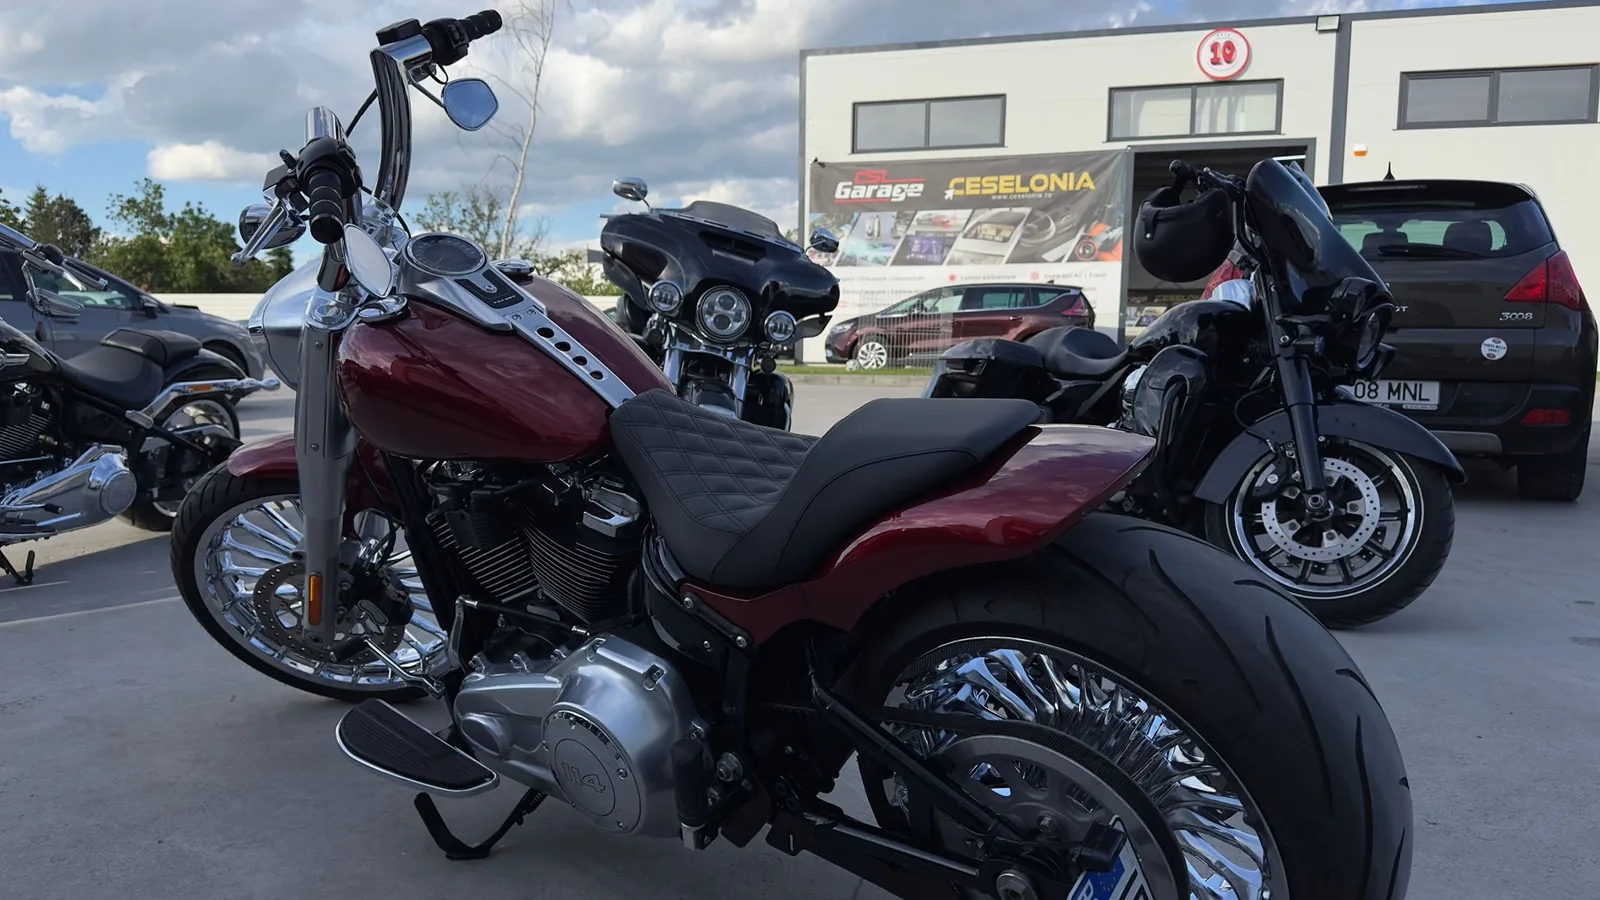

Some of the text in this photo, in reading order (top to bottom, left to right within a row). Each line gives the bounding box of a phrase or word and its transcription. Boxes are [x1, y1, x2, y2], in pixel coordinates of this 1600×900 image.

[1210, 41, 1237, 65] 10
[834, 181, 925, 202] Garage
[949, 171, 1096, 197] CESELONIA
[1500, 312, 1533, 320] 3008
[1354, 381, 1430, 401] 08 MNL
[562, 761, 606, 794] 114
